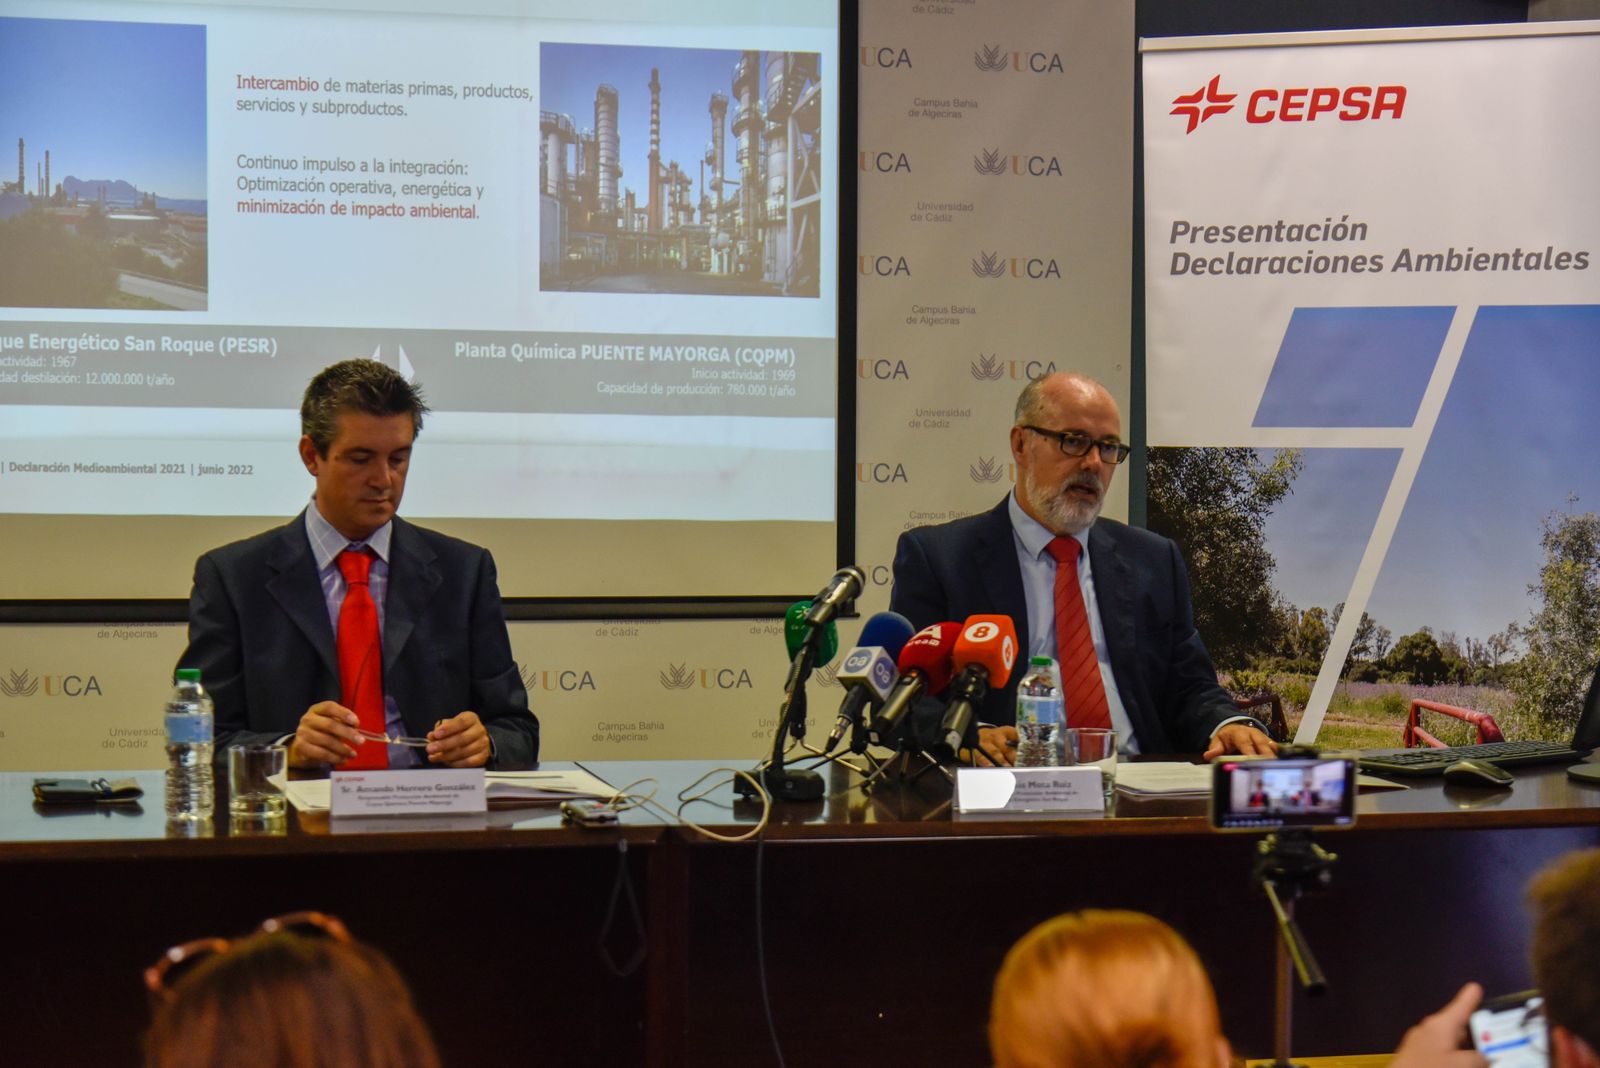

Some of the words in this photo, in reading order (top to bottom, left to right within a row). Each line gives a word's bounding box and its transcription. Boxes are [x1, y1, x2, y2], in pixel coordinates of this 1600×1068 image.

[860, 47, 912, 69] UCA
[1012, 52, 1064, 73] UCA
[236, 75, 319, 92] Intercambio
[323, 79, 341, 92] de
[345, 81, 404, 95] materias
[408, 82, 458, 99] primas,
[462, 84, 534, 102] productos,
[236, 99, 295, 113] servicios
[299, 103, 308, 116] y
[312, 101, 408, 119] subproductos.
[913, 97, 950, 109] Campus
[1245, 85, 1407, 124] CEPSA
[908, 109, 919, 118] de
[922, 109, 962, 120] Algeciras
[236, 155, 298, 172] Continuo
[302, 157, 356, 176] impulso
[360, 163, 369, 173] a
[373, 158, 385, 174] la
[389, 159, 469, 179] integración:
[859, 151, 911, 173] UCA
[1011, 155, 1063, 176] UCA
[236, 176, 325, 195] Optimización
[329, 179, 398, 198] operativa,
[401, 182, 471, 200] energética
[475, 187, 484, 200] y
[236, 199, 324, 215] minimización
[329, 201, 347, 215] de
[351, 203, 405, 220] impacto
[409, 204, 480, 220] ambiental.
[917, 201, 974, 212] Universidad
[910, 213, 922, 222] de
[1169, 214, 1368, 244] Presentación
[858, 255, 911, 277] UCA
[1010, 257, 1061, 279] UCA
[1169, 250, 1384, 275] Declaraciones
[1391, 246, 1590, 273] Ambientales
[911, 305, 948, 316] Campus
[906, 316, 917, 325] de
[920, 316, 960, 326] Algeciras
[29, 334, 120, 353] Energético
[124, 336, 155, 351] San
[160, 336, 214, 356] Roque
[218, 338, 278, 357] (PESR)
[51, 356, 77, 368] 1967
[455, 342, 506, 360] Planta
[511, 342, 576, 362] Química
[581, 345, 644, 361] PUENTE
[649, 347, 730, 363] MAYORGA
[735, 347, 796, 368] (CQPM)
[691, 368, 719, 379] Inicio
[722, 370, 768, 381] actividad:
[772, 370, 796, 381] 1969
[857, 358, 909, 381] UCA
[21, 372, 81, 384] destilación:
[86, 372, 144, 385] 12.000.000
[147, 374, 175, 386] t/año
[597, 382, 648, 396] Capacidad
[652, 384, 663, 395] de
[667, 384, 724, 398] producción:
[728, 384, 767, 396] 780.000
[770, 386, 796, 397] t/año
[915, 408, 971, 418] Universidad
[908, 419, 920, 428] de
[9, 461, 70, 473] Declaración
[73, 463, 157, 474] Medioambiental
[160, 464, 185, 473] 2021
[198, 464, 225, 476] junio
[228, 465, 253, 475] 2022
[857, 462, 908, 483] UCA
[909, 511, 946, 521] Campus
[97, 630, 110, 639] de
[113, 629, 158, 640] Algeciras
[595, 628, 608, 637] de
[750, 626, 761, 635] de
[973, 626, 990, 638] 8
[44, 675, 103, 697] UCA
[542, 670, 596, 691] UCA
[700, 668, 753, 689] UCA
[109, 727, 166, 737] Universida
[597, 721, 636, 733] Campus
[751, 730, 764, 738] de
[102, 738, 115, 748] de
[592, 732, 604, 741] de
[607, 732, 648, 743] Algeciras
